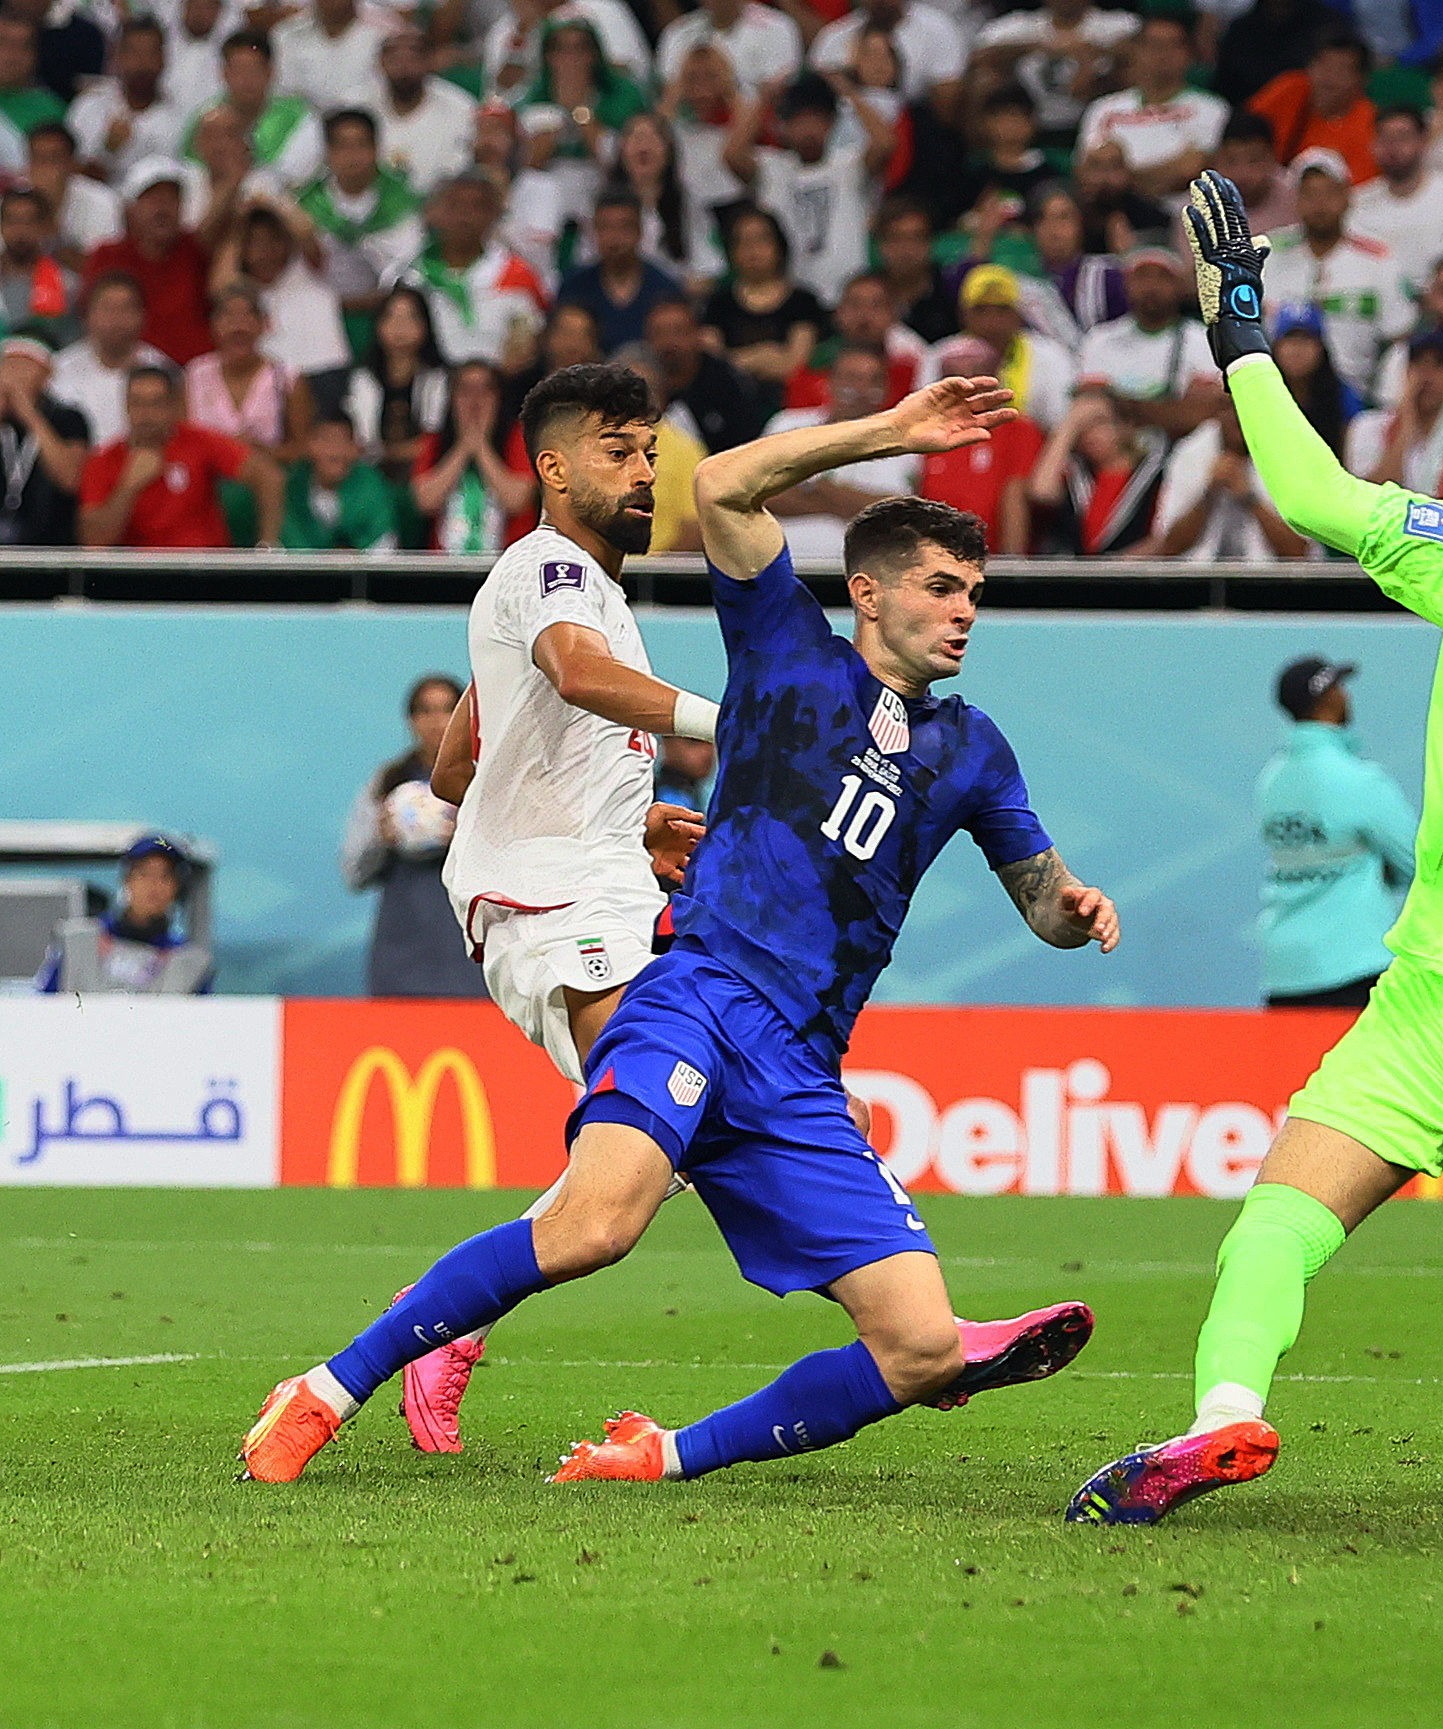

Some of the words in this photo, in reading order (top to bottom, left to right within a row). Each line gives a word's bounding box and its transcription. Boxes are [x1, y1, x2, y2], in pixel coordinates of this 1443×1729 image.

[820, 774, 896, 860] 10
[15, 1074, 247, 1168] قطر
[678, 1063, 704, 1089] USA
[841, 1056, 1290, 1201] Delive
